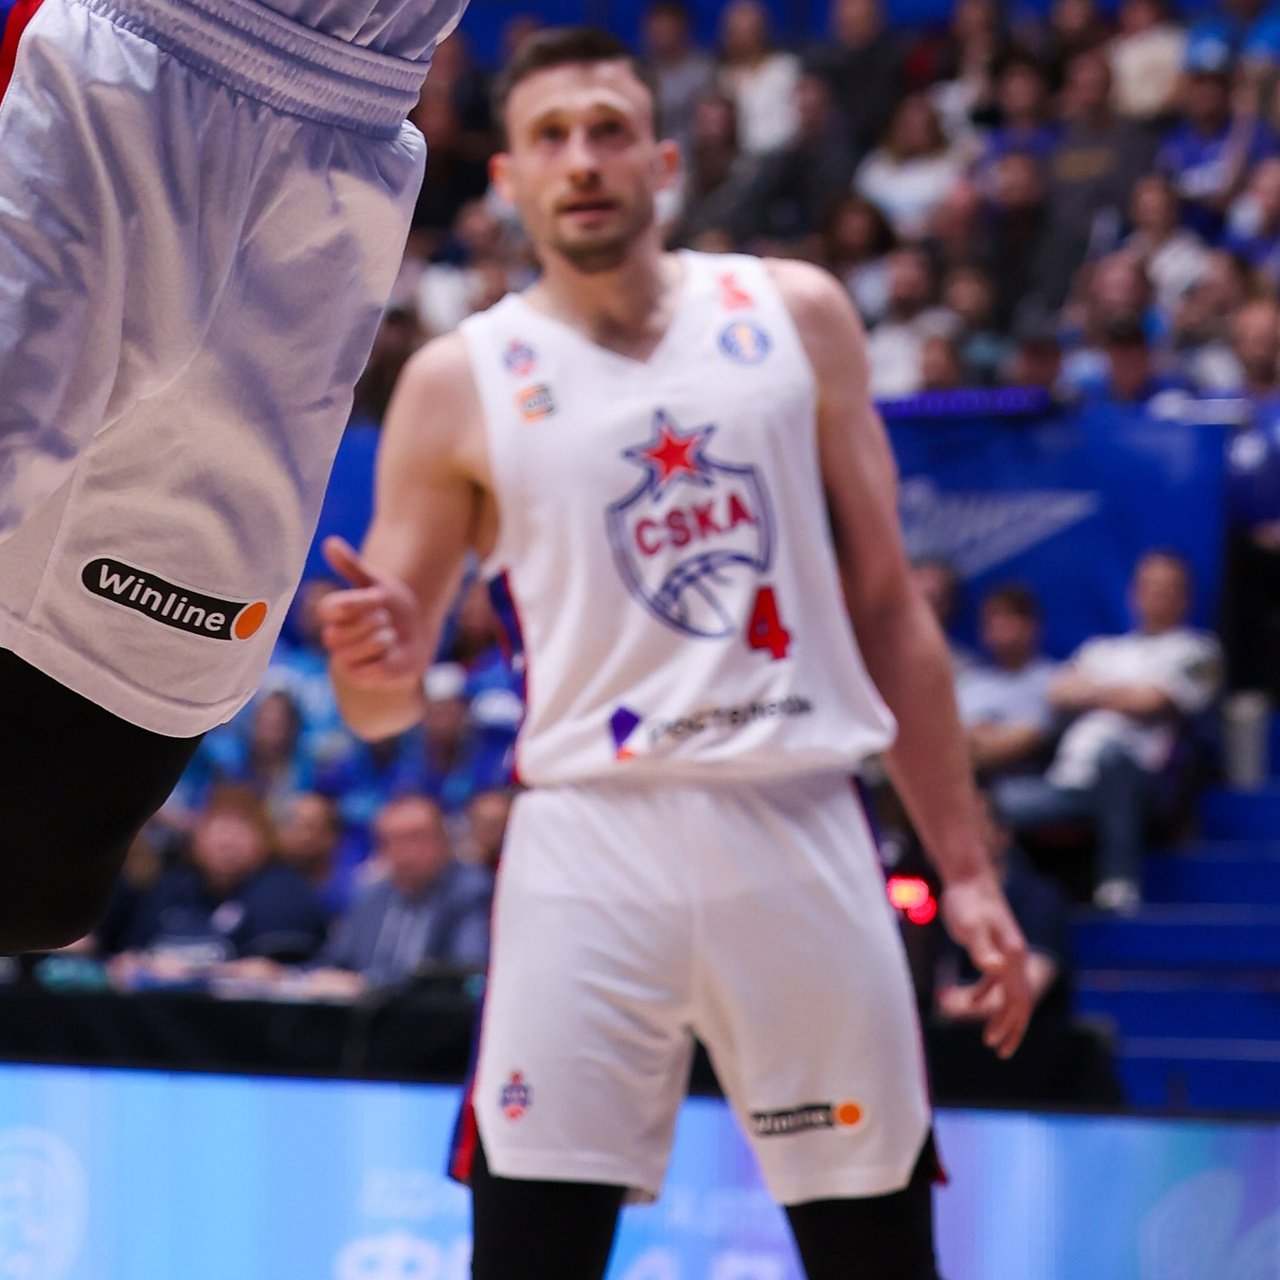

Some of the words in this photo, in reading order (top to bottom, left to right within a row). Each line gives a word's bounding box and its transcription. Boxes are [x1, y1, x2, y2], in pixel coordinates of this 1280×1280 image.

[634, 492, 758, 556] CSKA
[98, 563, 226, 632] Winline
[746, 586, 791, 660] 4
